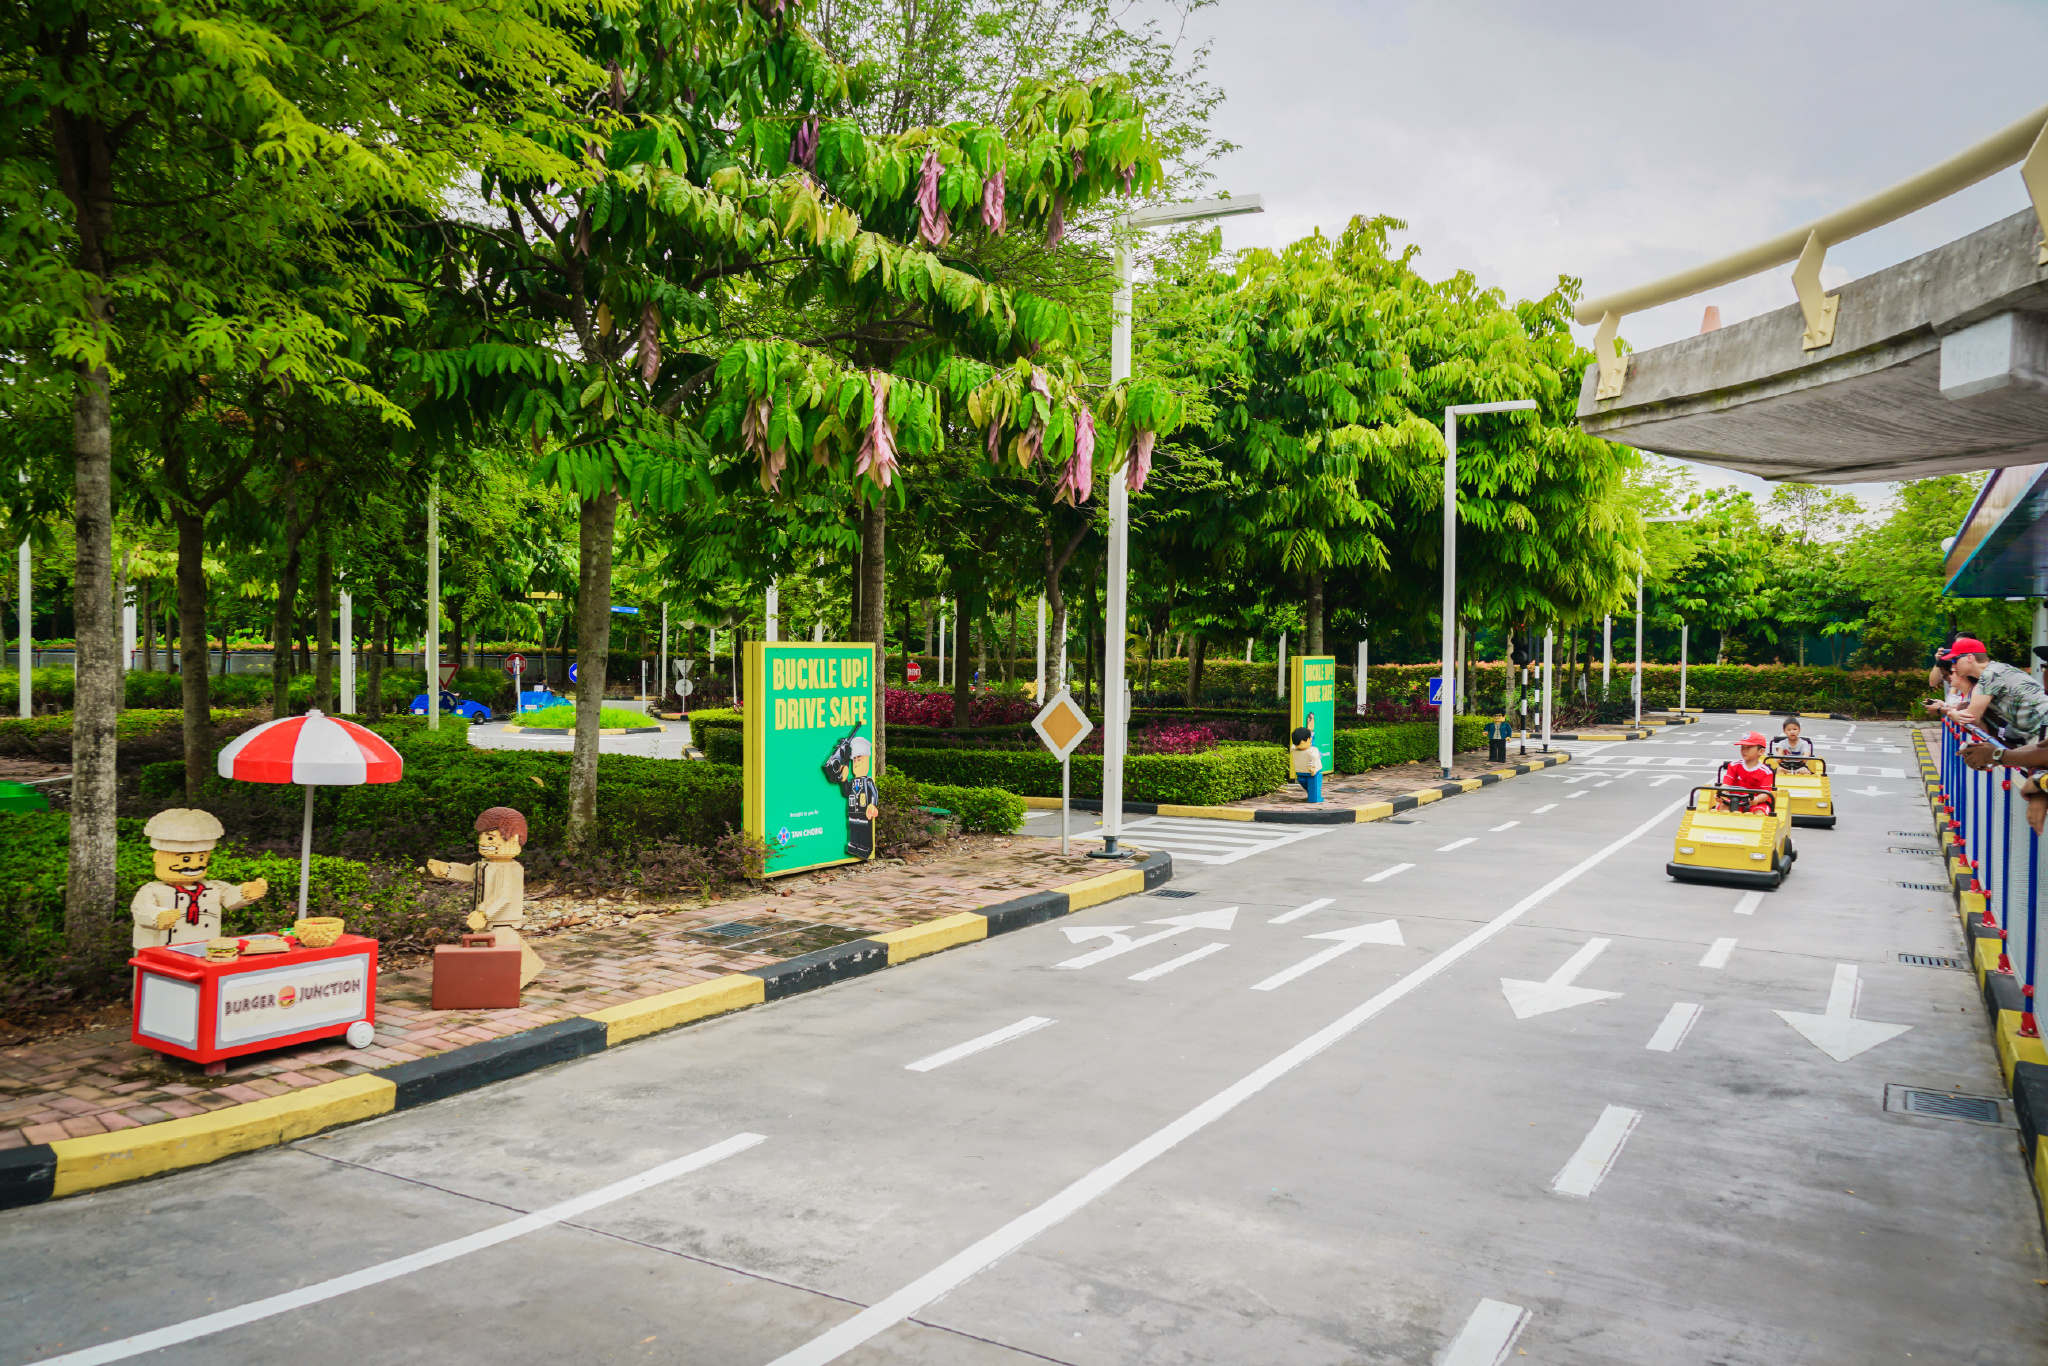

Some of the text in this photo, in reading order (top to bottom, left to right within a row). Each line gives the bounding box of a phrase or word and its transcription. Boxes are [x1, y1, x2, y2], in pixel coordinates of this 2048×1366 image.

[773, 657, 867, 690] BUCKLE UP!
[1306, 664, 1324, 681] BUCKLE
[1322, 685, 1332, 701] SAFE
[775, 696, 866, 730] DRIVE SAFE
[803, 827, 823, 837] CHONG
[225, 978, 360, 1015] BURGER JUNCTION
